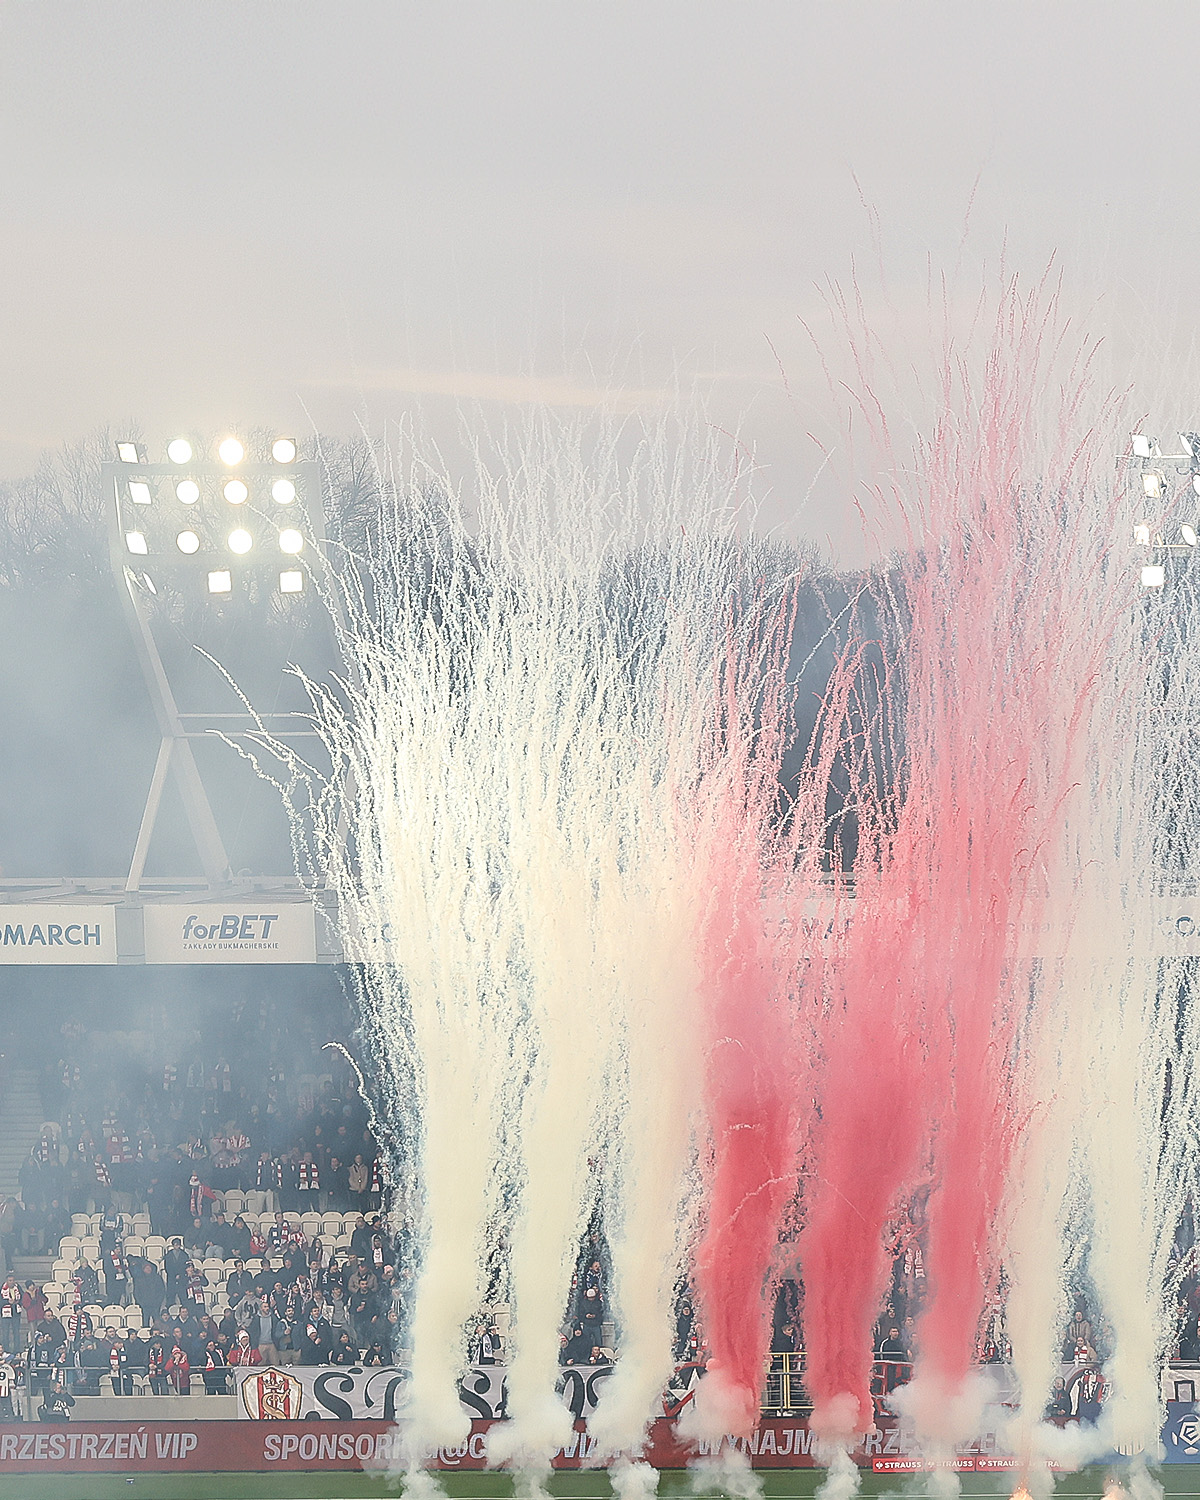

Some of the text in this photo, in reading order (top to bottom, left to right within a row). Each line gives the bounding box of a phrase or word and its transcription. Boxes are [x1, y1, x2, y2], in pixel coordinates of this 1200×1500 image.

[182, 914, 279, 940] forBET
[218, 942, 279, 950] BUKMACHERSKIE
[155, 1433, 198, 1459] VIP
[885, 1461, 922, 1469] STRAUSS
